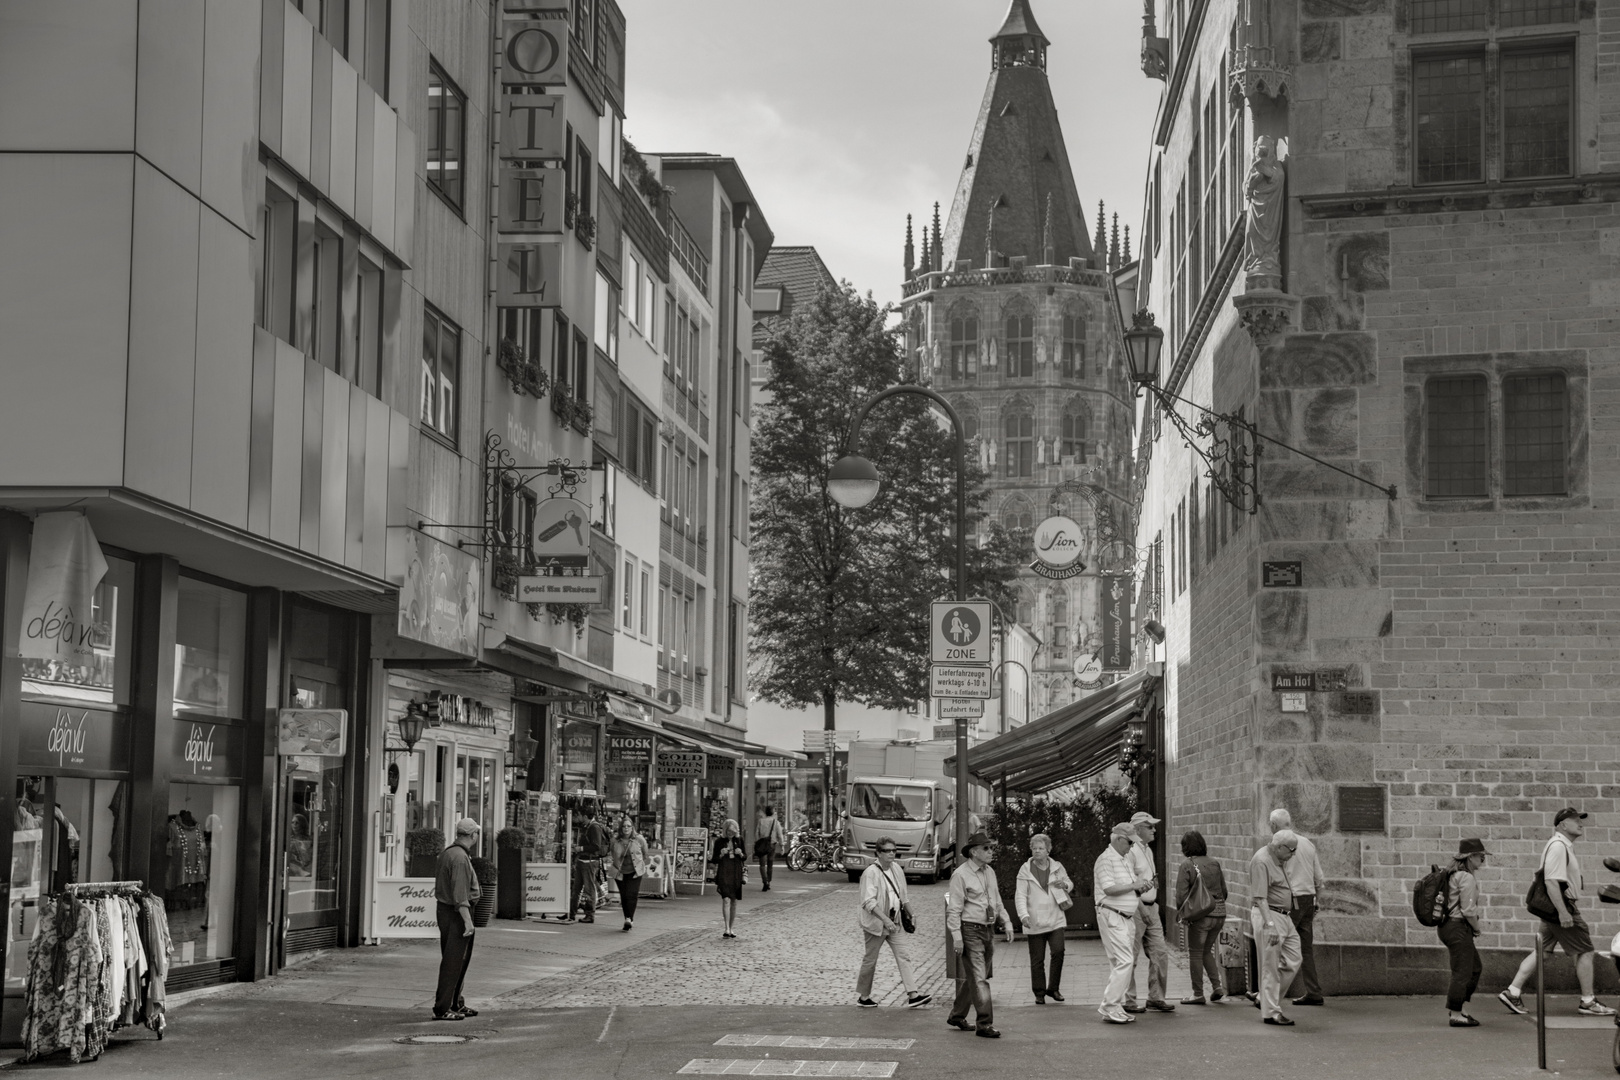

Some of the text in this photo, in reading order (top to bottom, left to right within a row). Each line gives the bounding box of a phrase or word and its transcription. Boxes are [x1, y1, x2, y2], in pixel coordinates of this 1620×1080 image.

[507, 412, 530, 454] Hotel
[1039, 530, 1078, 551] Sion
[1034, 564, 1082, 579] BRAUHAUS
[523, 585, 545, 594] Hotel
[27, 601, 74, 654] déjà
[1110, 619, 1120, 666] Brauhaus
[946, 649, 976, 659] ZONE
[938, 669, 985, 679] Lieferfahrzeuge
[1077, 661, 1099, 675] Sion
[937, 679, 964, 687] werktags
[1276, 675, 1291, 687] Am
[1295, 675, 1311, 687] Hof
[48, 708, 72, 767] déjà
[611, 738, 651, 748] KIOSK
[185, 723, 203, 774] déjà
[744, 757, 797, 767] ouvenirs
[526, 871, 549, 880] Hotel
[399, 885, 435, 898] Hotel
[526, 893, 555, 902] useum
[405, 905, 425, 913] am
